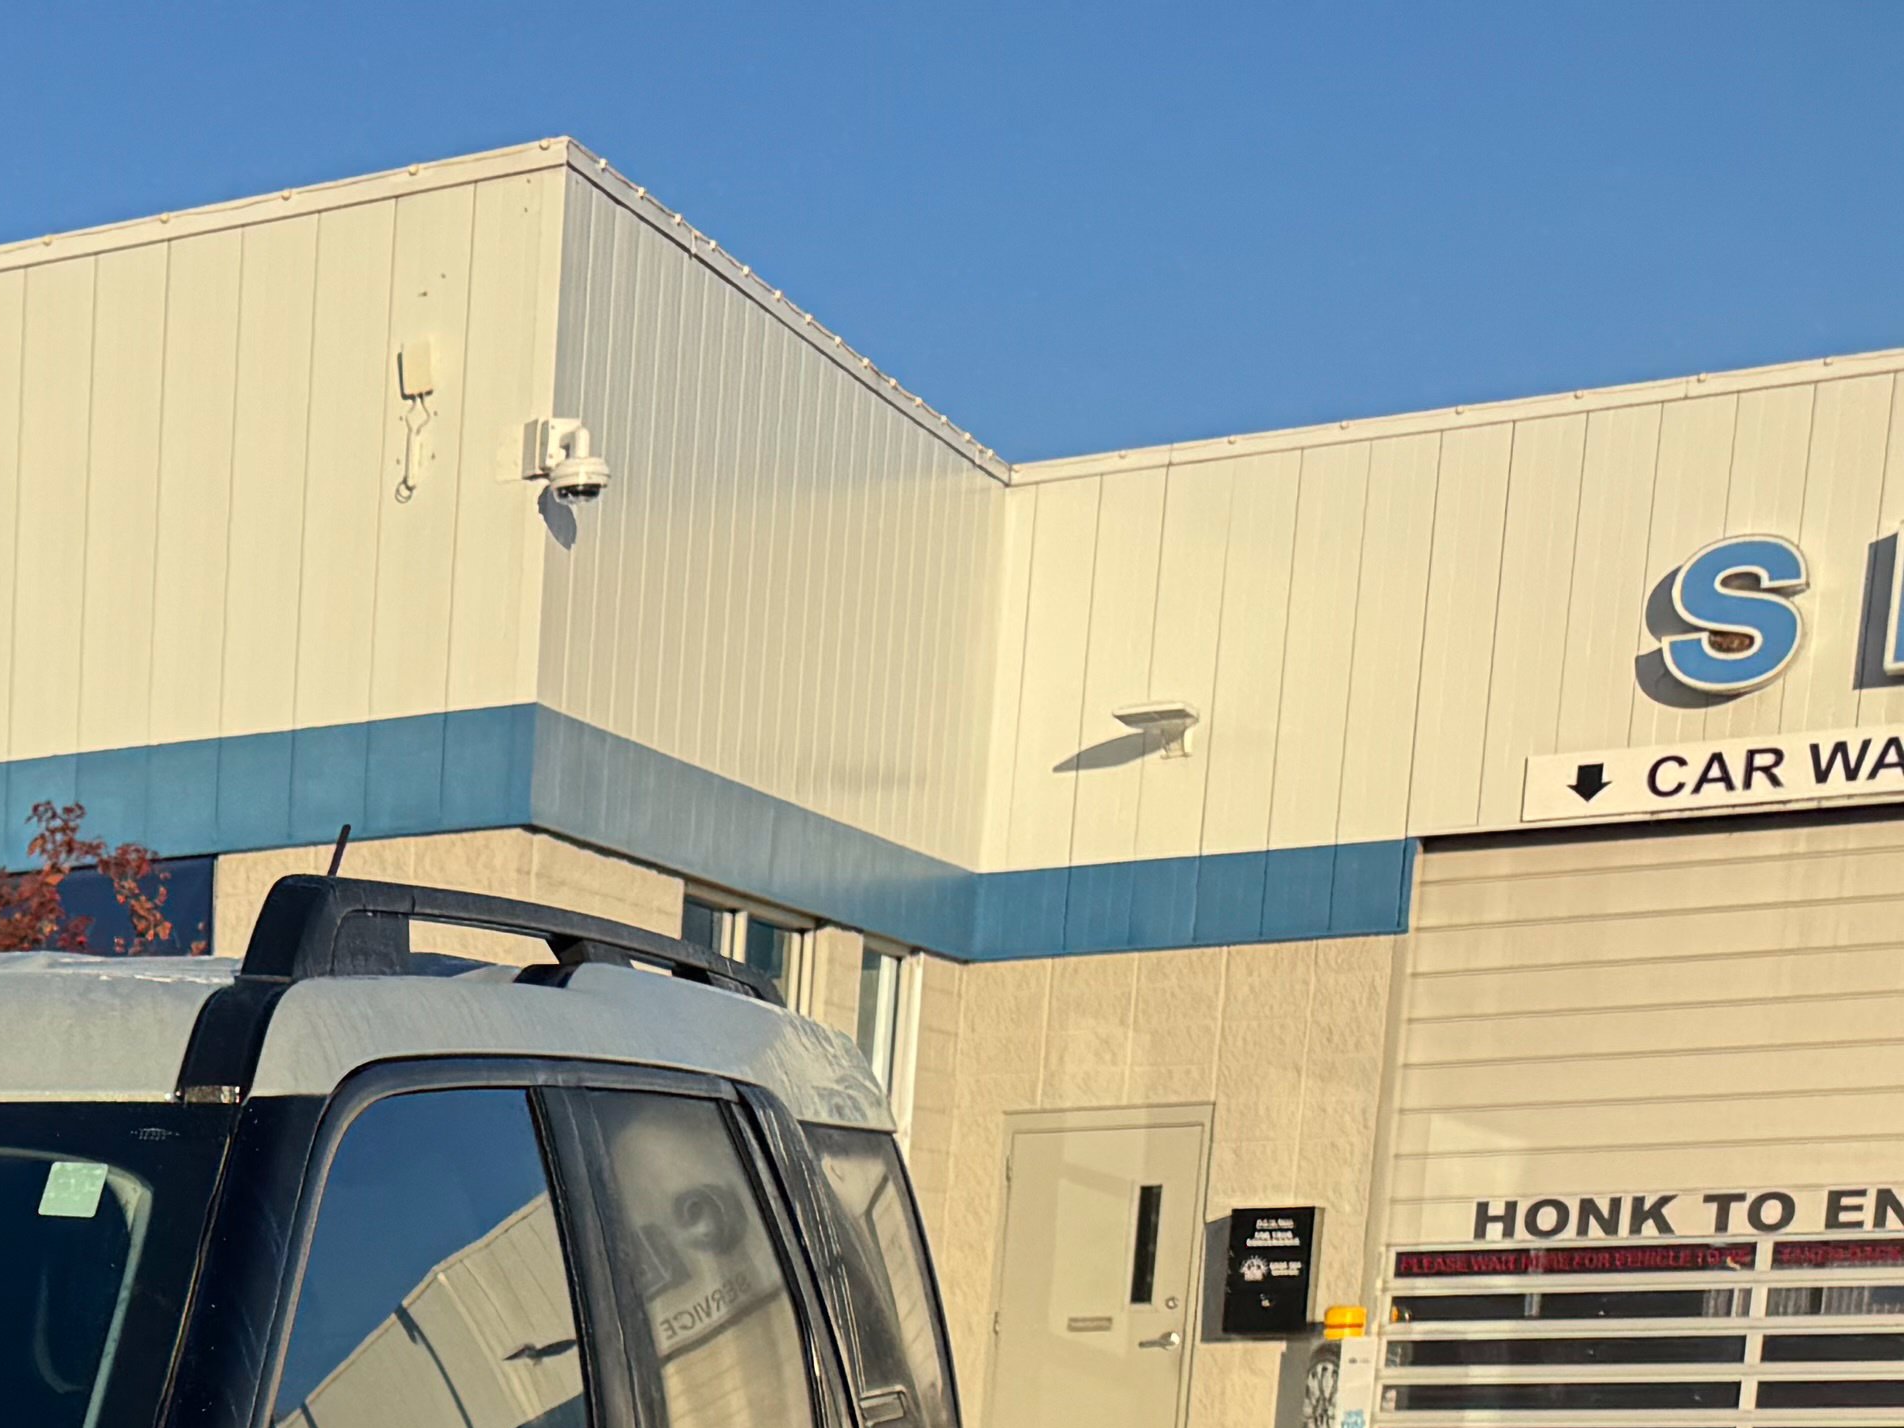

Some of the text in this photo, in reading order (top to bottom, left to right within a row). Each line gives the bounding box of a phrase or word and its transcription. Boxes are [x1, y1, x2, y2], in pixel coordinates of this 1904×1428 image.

[1646, 746, 1785, 798] CAR
[1473, 1193, 1679, 1241] HONK
[1702, 1190, 1796, 1234] TO
[1399, 1255, 1469, 1274] PLEASE
[1471, 1254, 1517, 1272] WAIT
[1573, 1251, 1610, 1270] FOR
